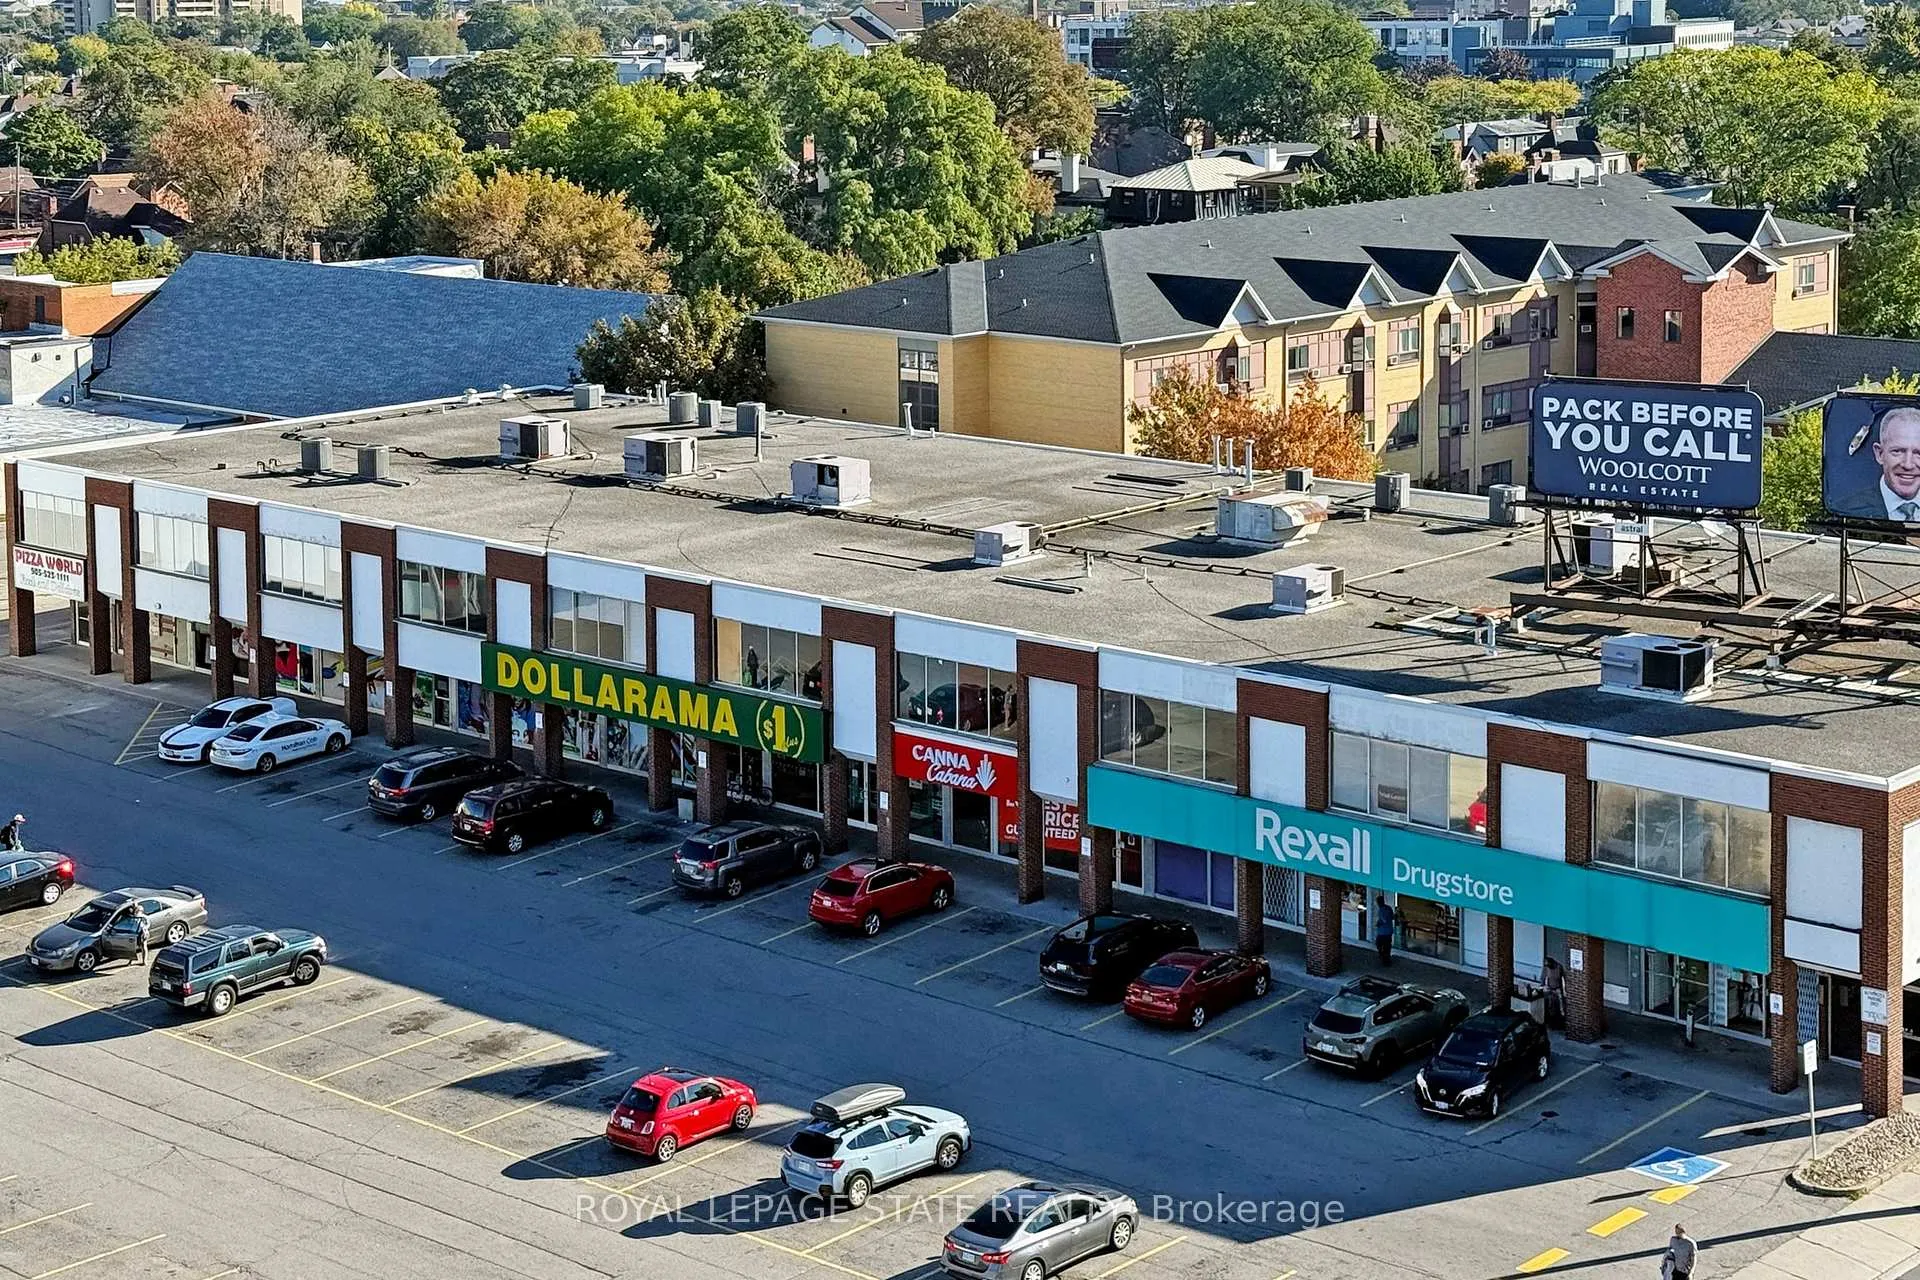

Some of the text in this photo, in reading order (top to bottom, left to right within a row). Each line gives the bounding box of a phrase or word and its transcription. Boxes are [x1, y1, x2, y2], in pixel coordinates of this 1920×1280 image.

[1542, 397, 1752, 430] PACK BEFORE
[1543, 421, 1751, 462] YOU CALL
[1578, 456, 1712, 484] WOOLCOTT
[1589, 482, 1699, 498] REAL ESTATE
[1621, 525, 1643, 533] astral
[15, 549, 83, 576] PIZZA WORLD
[497, 652, 738, 737] DOLLARAMA
[912, 744, 971, 771] CANNA
[926, 764, 977, 789] Cabana
[1045, 811, 1079, 829] RICE
[1255, 807, 1371, 875] Rexall
[1393, 857, 1513, 905] Drugstore
